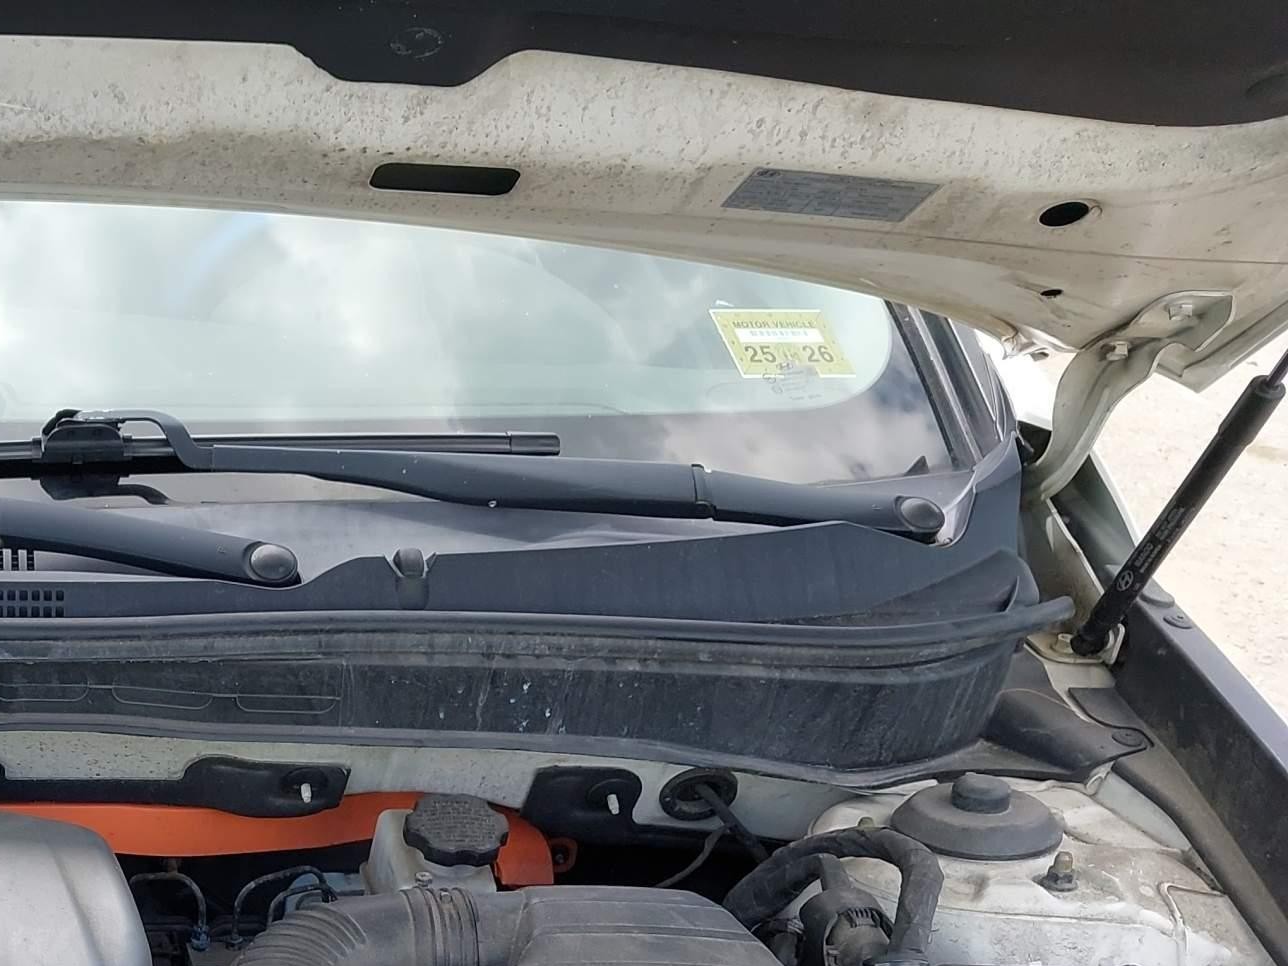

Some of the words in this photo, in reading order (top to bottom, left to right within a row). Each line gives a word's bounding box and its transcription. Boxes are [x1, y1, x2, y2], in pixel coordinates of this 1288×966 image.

[732, 320, 770, 328] MOTOR
[773, 320, 816, 328] VEHICLE
[744, 345, 777, 363] 25
[802, 345, 834, 363] 26
